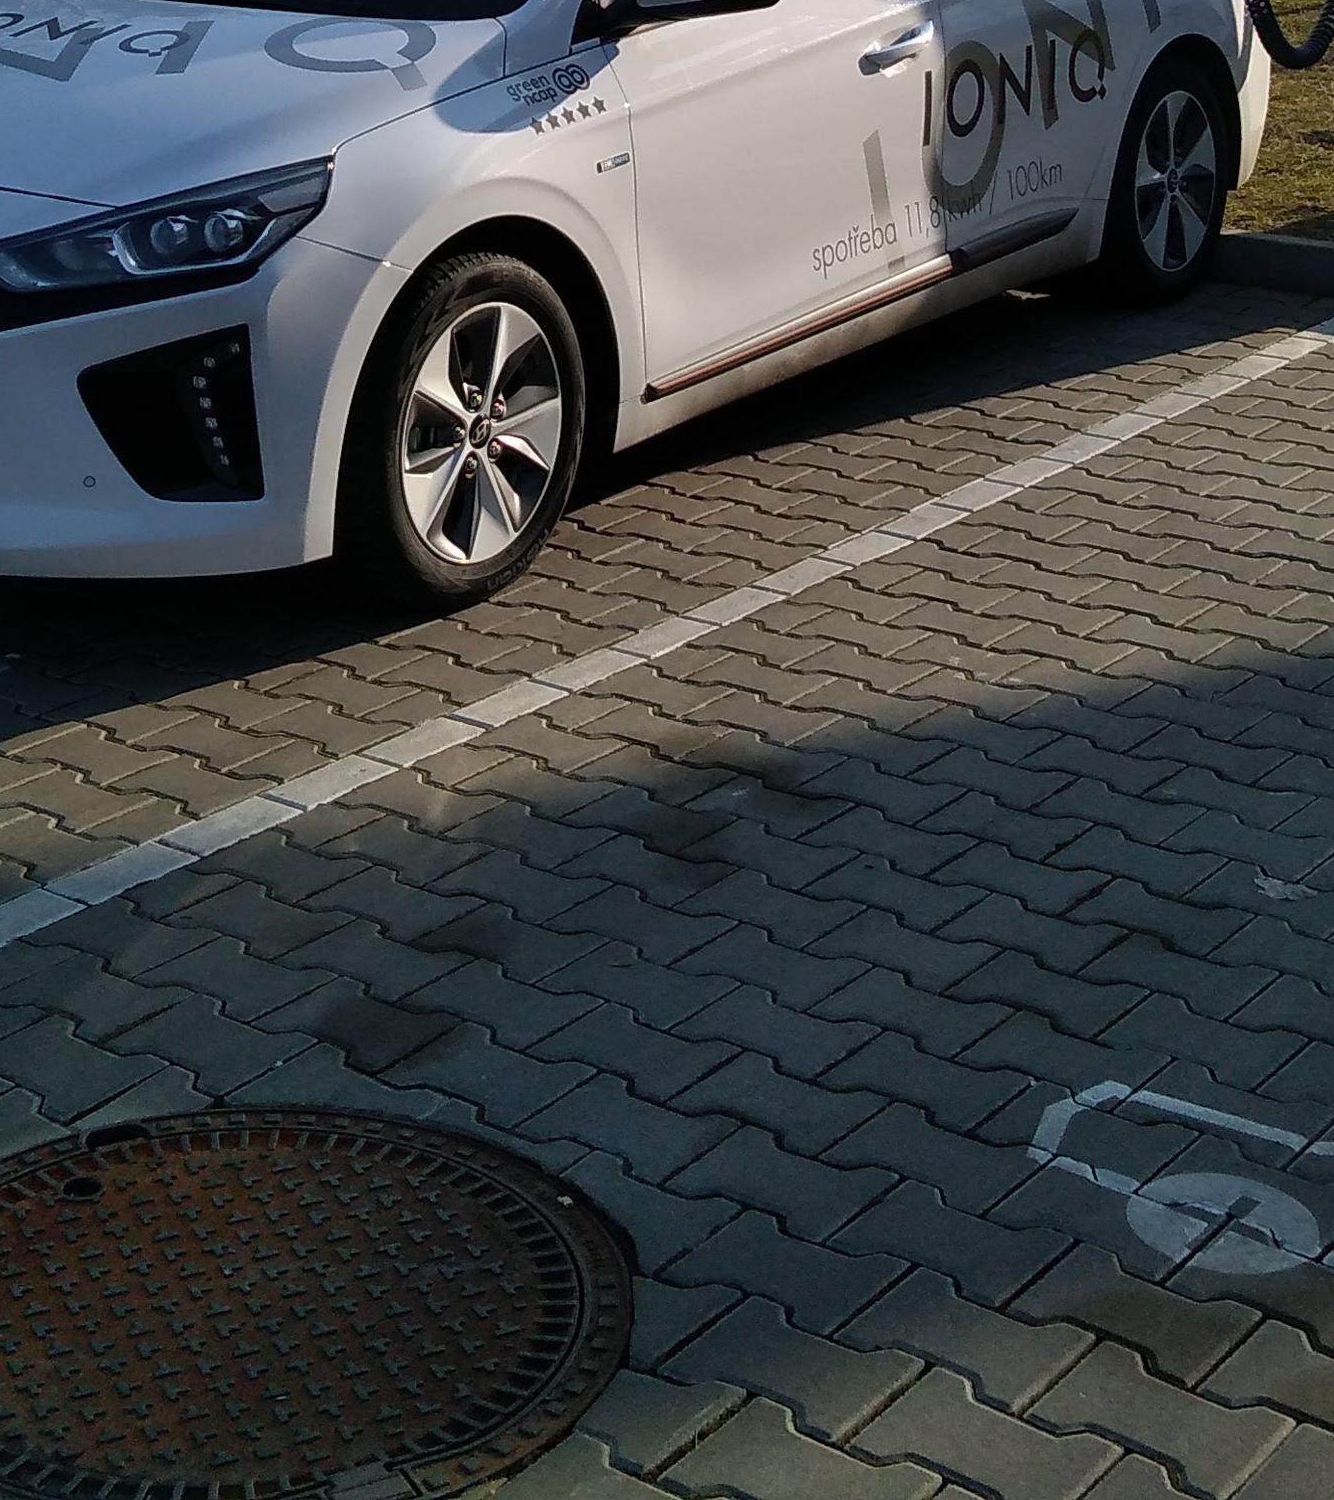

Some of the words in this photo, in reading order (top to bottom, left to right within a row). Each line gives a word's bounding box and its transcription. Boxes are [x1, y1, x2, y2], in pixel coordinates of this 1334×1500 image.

[507, 74, 551, 102] green
[522, 87, 558, 106] ncap
[922, 29, 1107, 147] IONIQ
[812, 214, 897, 280] spotřeba
[904, 195, 941, 239] 11,8
[1007, 156, 1063, 201] 100km
